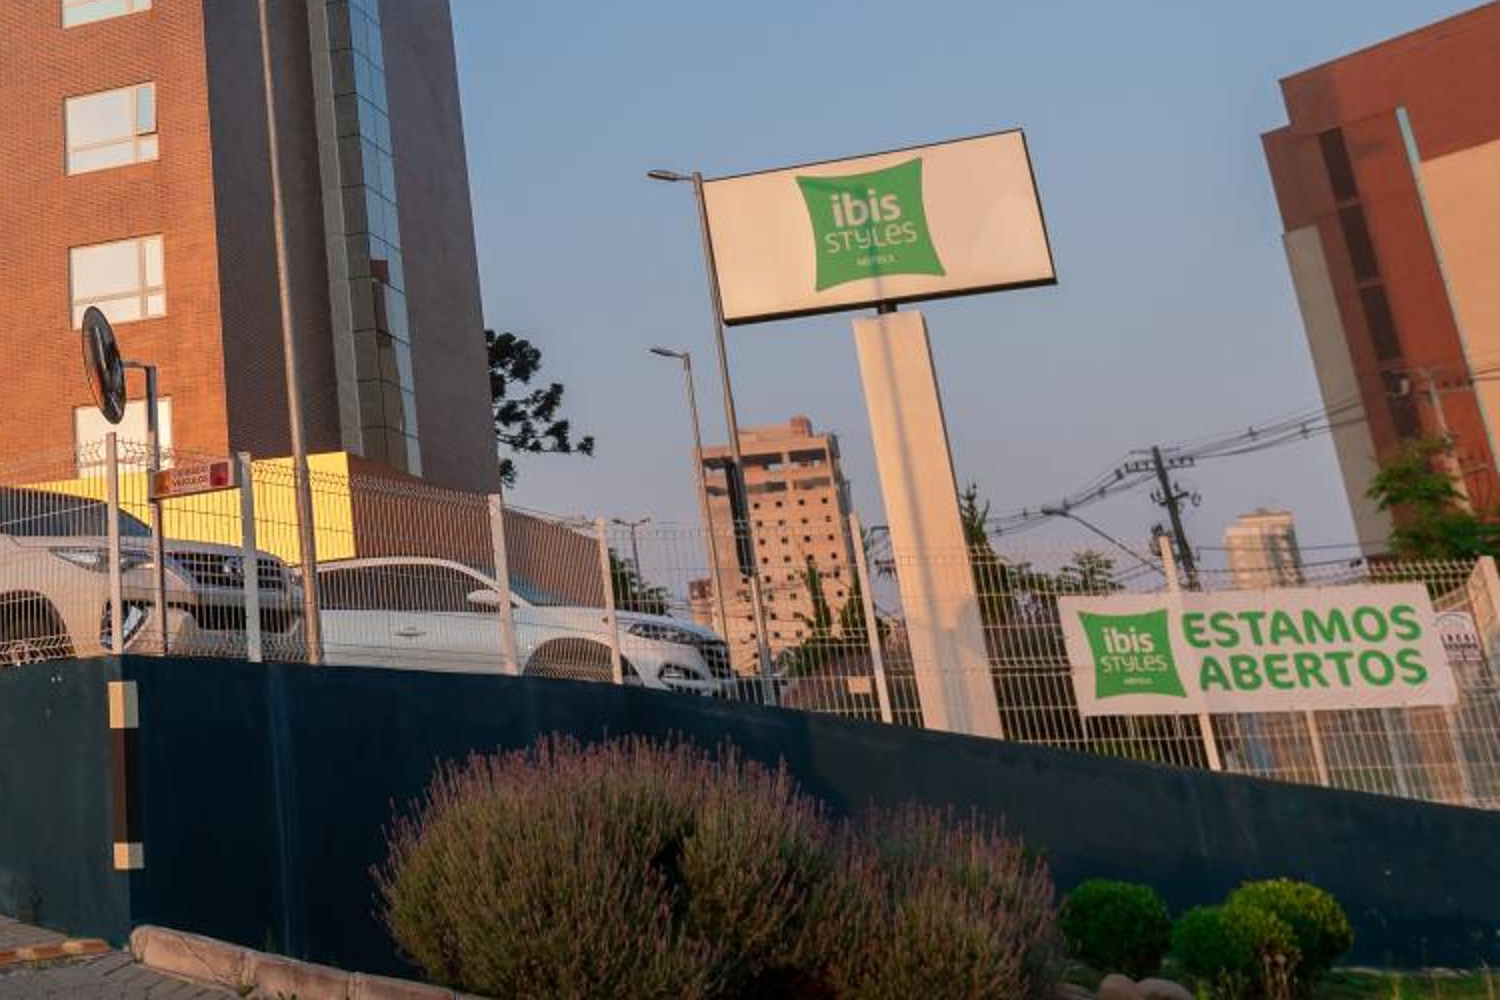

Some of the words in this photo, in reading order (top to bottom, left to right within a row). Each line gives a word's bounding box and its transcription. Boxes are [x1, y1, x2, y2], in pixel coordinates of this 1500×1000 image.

[830, 188, 902, 228] ibis
[1101, 625, 1156, 654] ibis
[1181, 604, 1422, 648] ESTAMOS
[1201, 648, 1429, 692] ABERTOS
